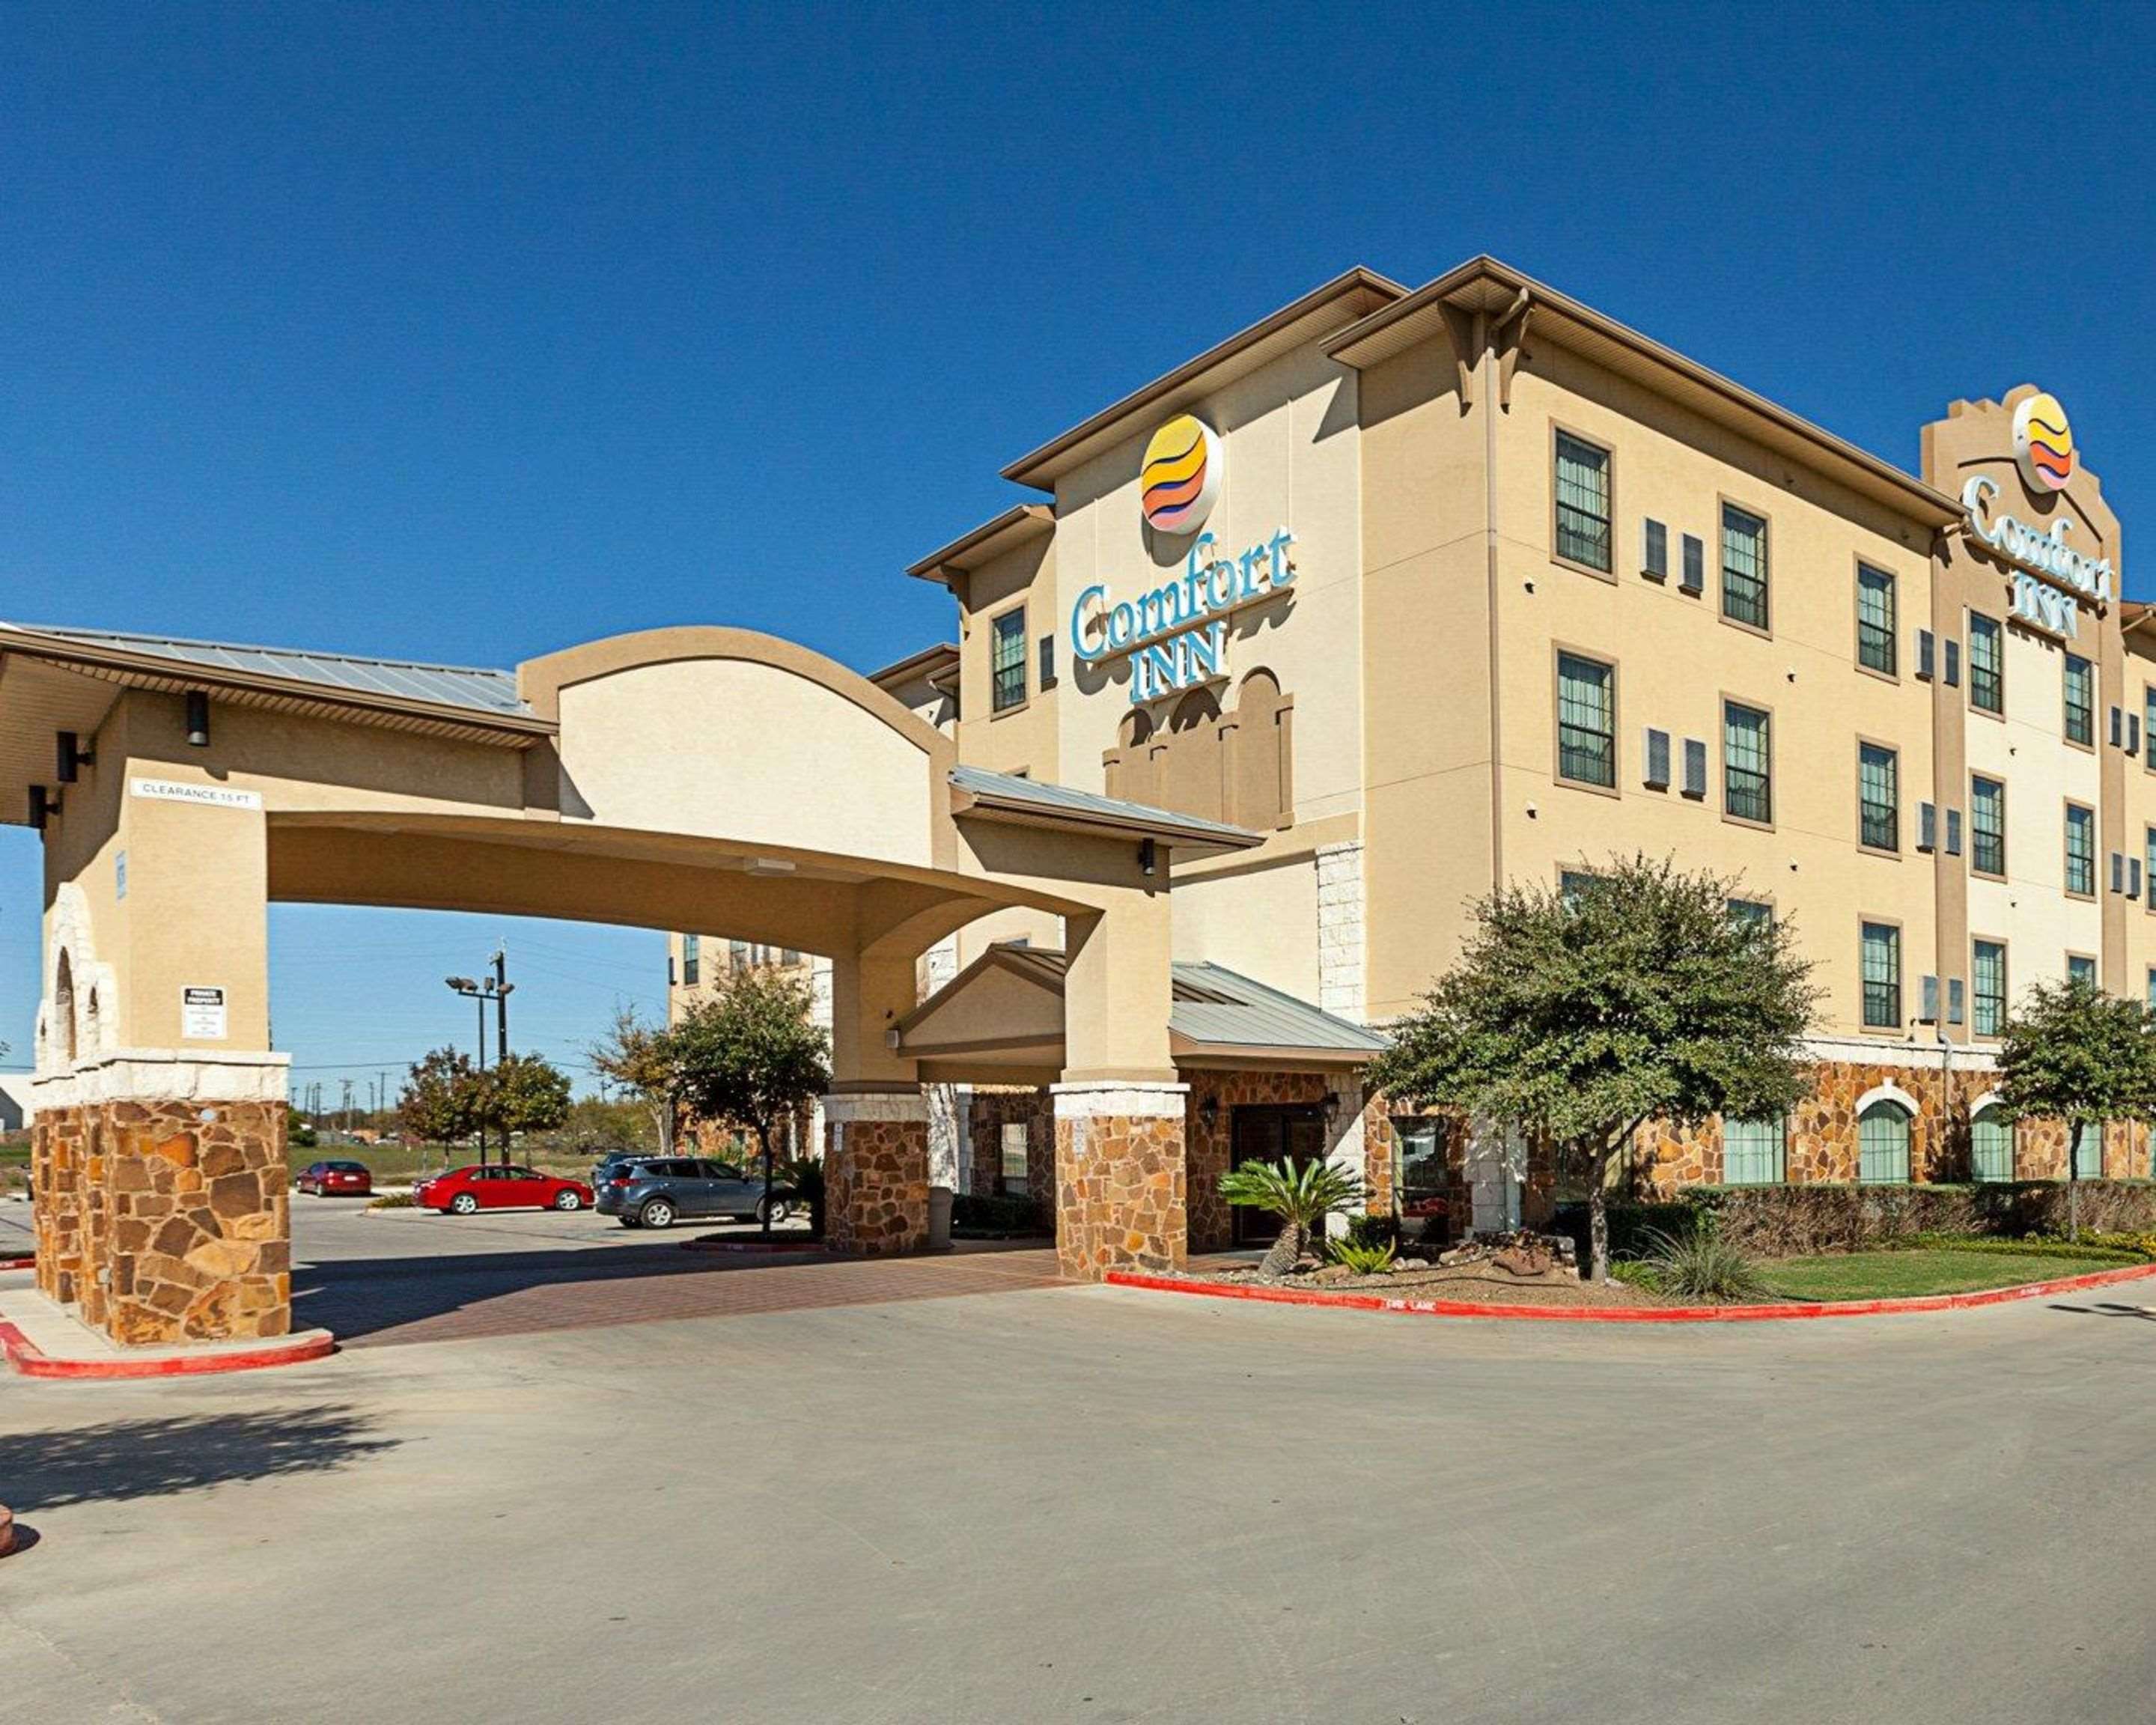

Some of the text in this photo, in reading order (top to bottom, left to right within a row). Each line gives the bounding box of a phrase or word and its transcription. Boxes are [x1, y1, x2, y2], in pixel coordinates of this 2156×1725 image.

[1964, 475, 2114, 603] Comfort
[1071, 529, 1298, 660] Comfort
[2009, 570, 2077, 638] INN
[1129, 621, 1225, 703] INN
[143, 783, 249, 803] CLEARANCE 15 FT
